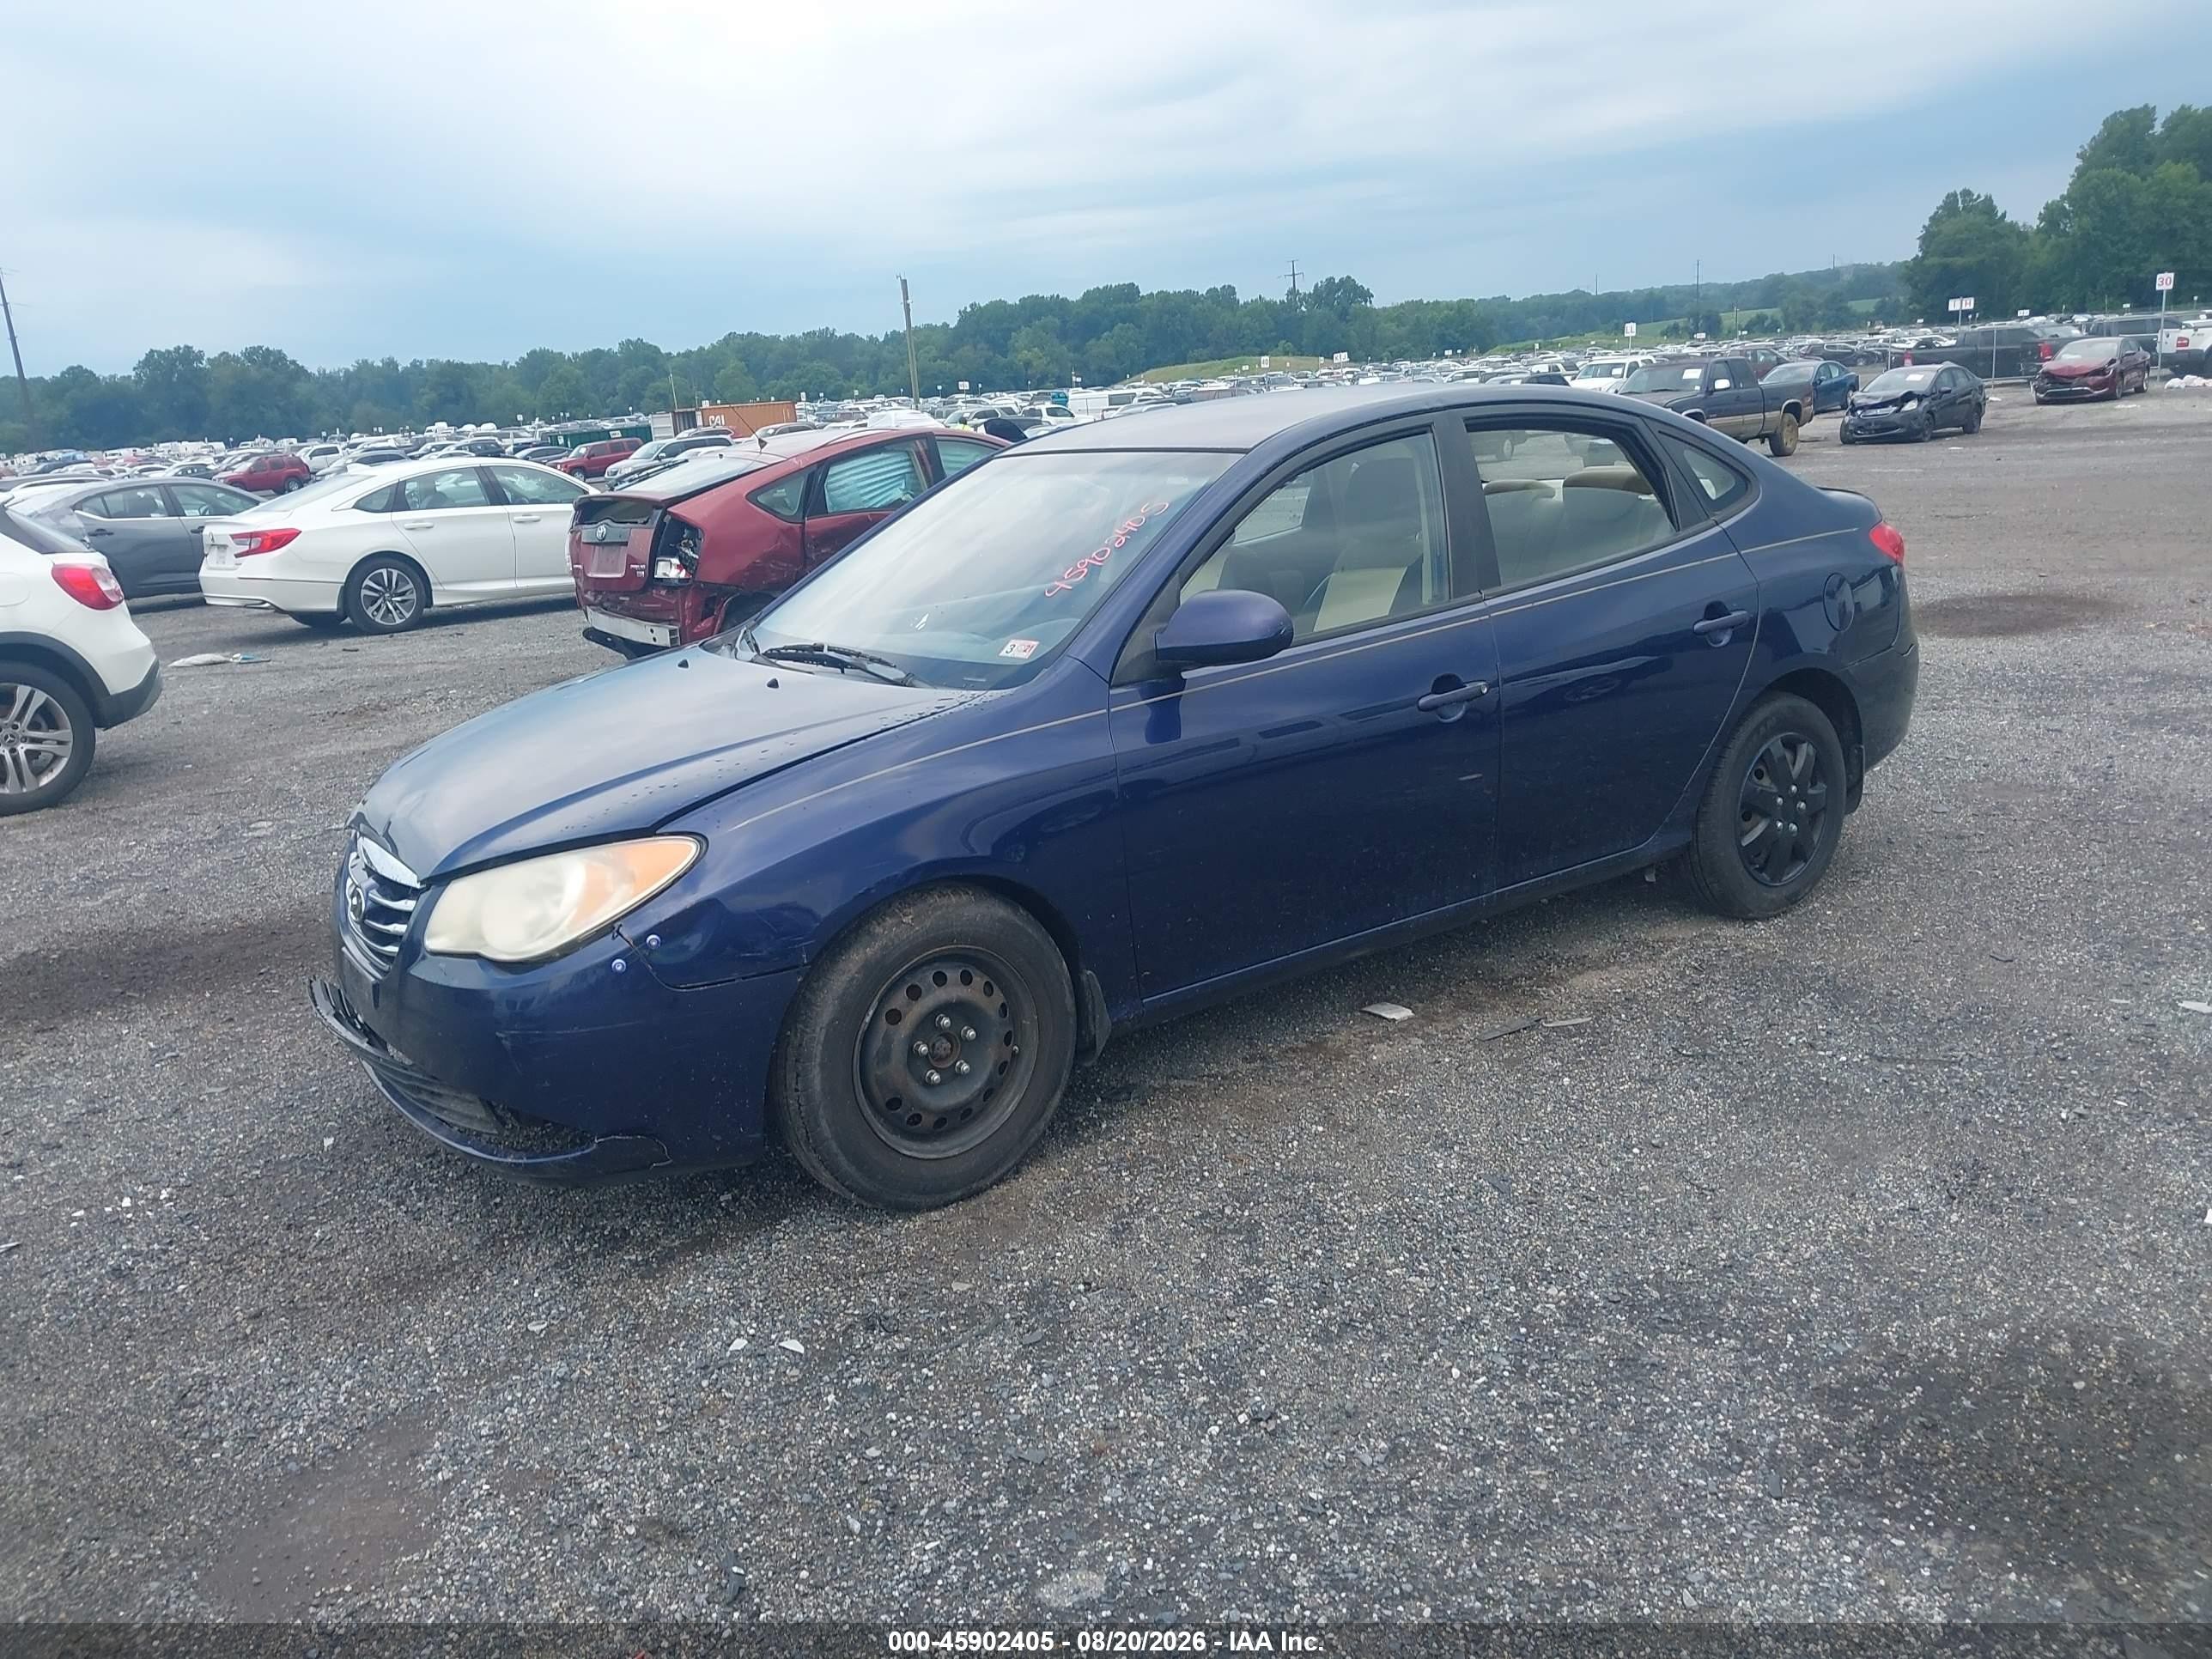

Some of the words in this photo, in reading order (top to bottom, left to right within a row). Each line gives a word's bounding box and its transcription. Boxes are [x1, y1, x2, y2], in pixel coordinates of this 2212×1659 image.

[2157, 276, 2172, 287] 30
[1044, 501, 1170, 597] 45902405
[1006, 644, 1016, 653] 3
